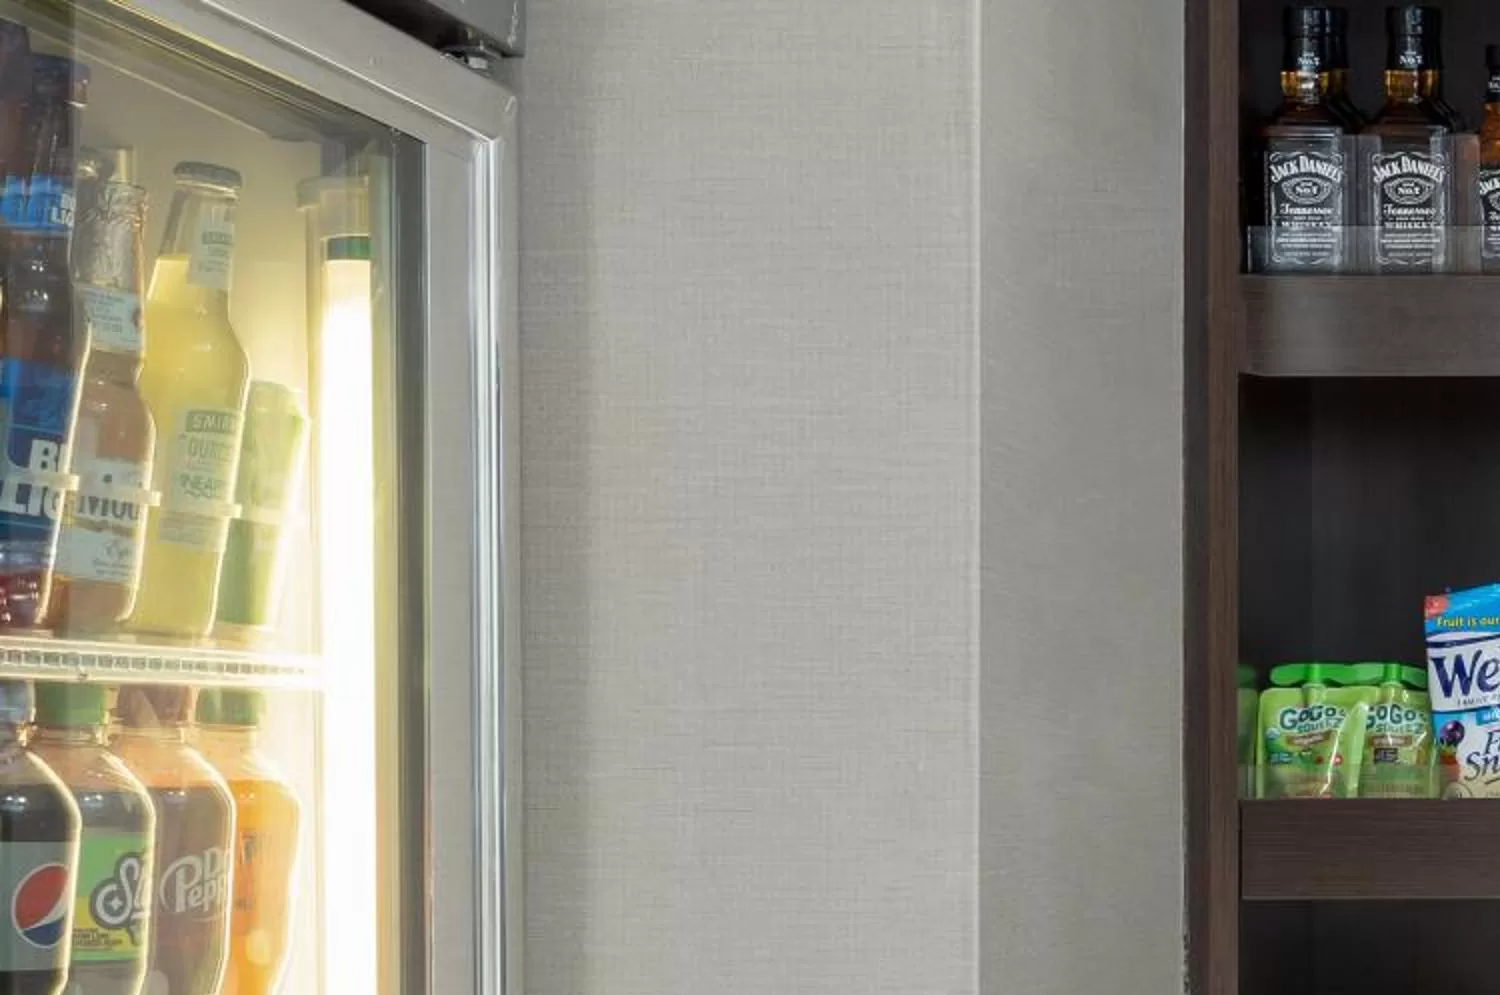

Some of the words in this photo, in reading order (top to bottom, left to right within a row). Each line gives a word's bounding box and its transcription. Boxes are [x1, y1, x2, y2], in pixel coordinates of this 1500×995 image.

[1269, 160, 1299, 183] JACK
[1300, 155, 1343, 183] DANIEL'S
[1372, 160, 1400, 183] JACK
[1400, 155, 1446, 183] DANIEL'S
[1479, 178, 1500, 195] JACK
[1436, 615, 1465, 628] Fruit
